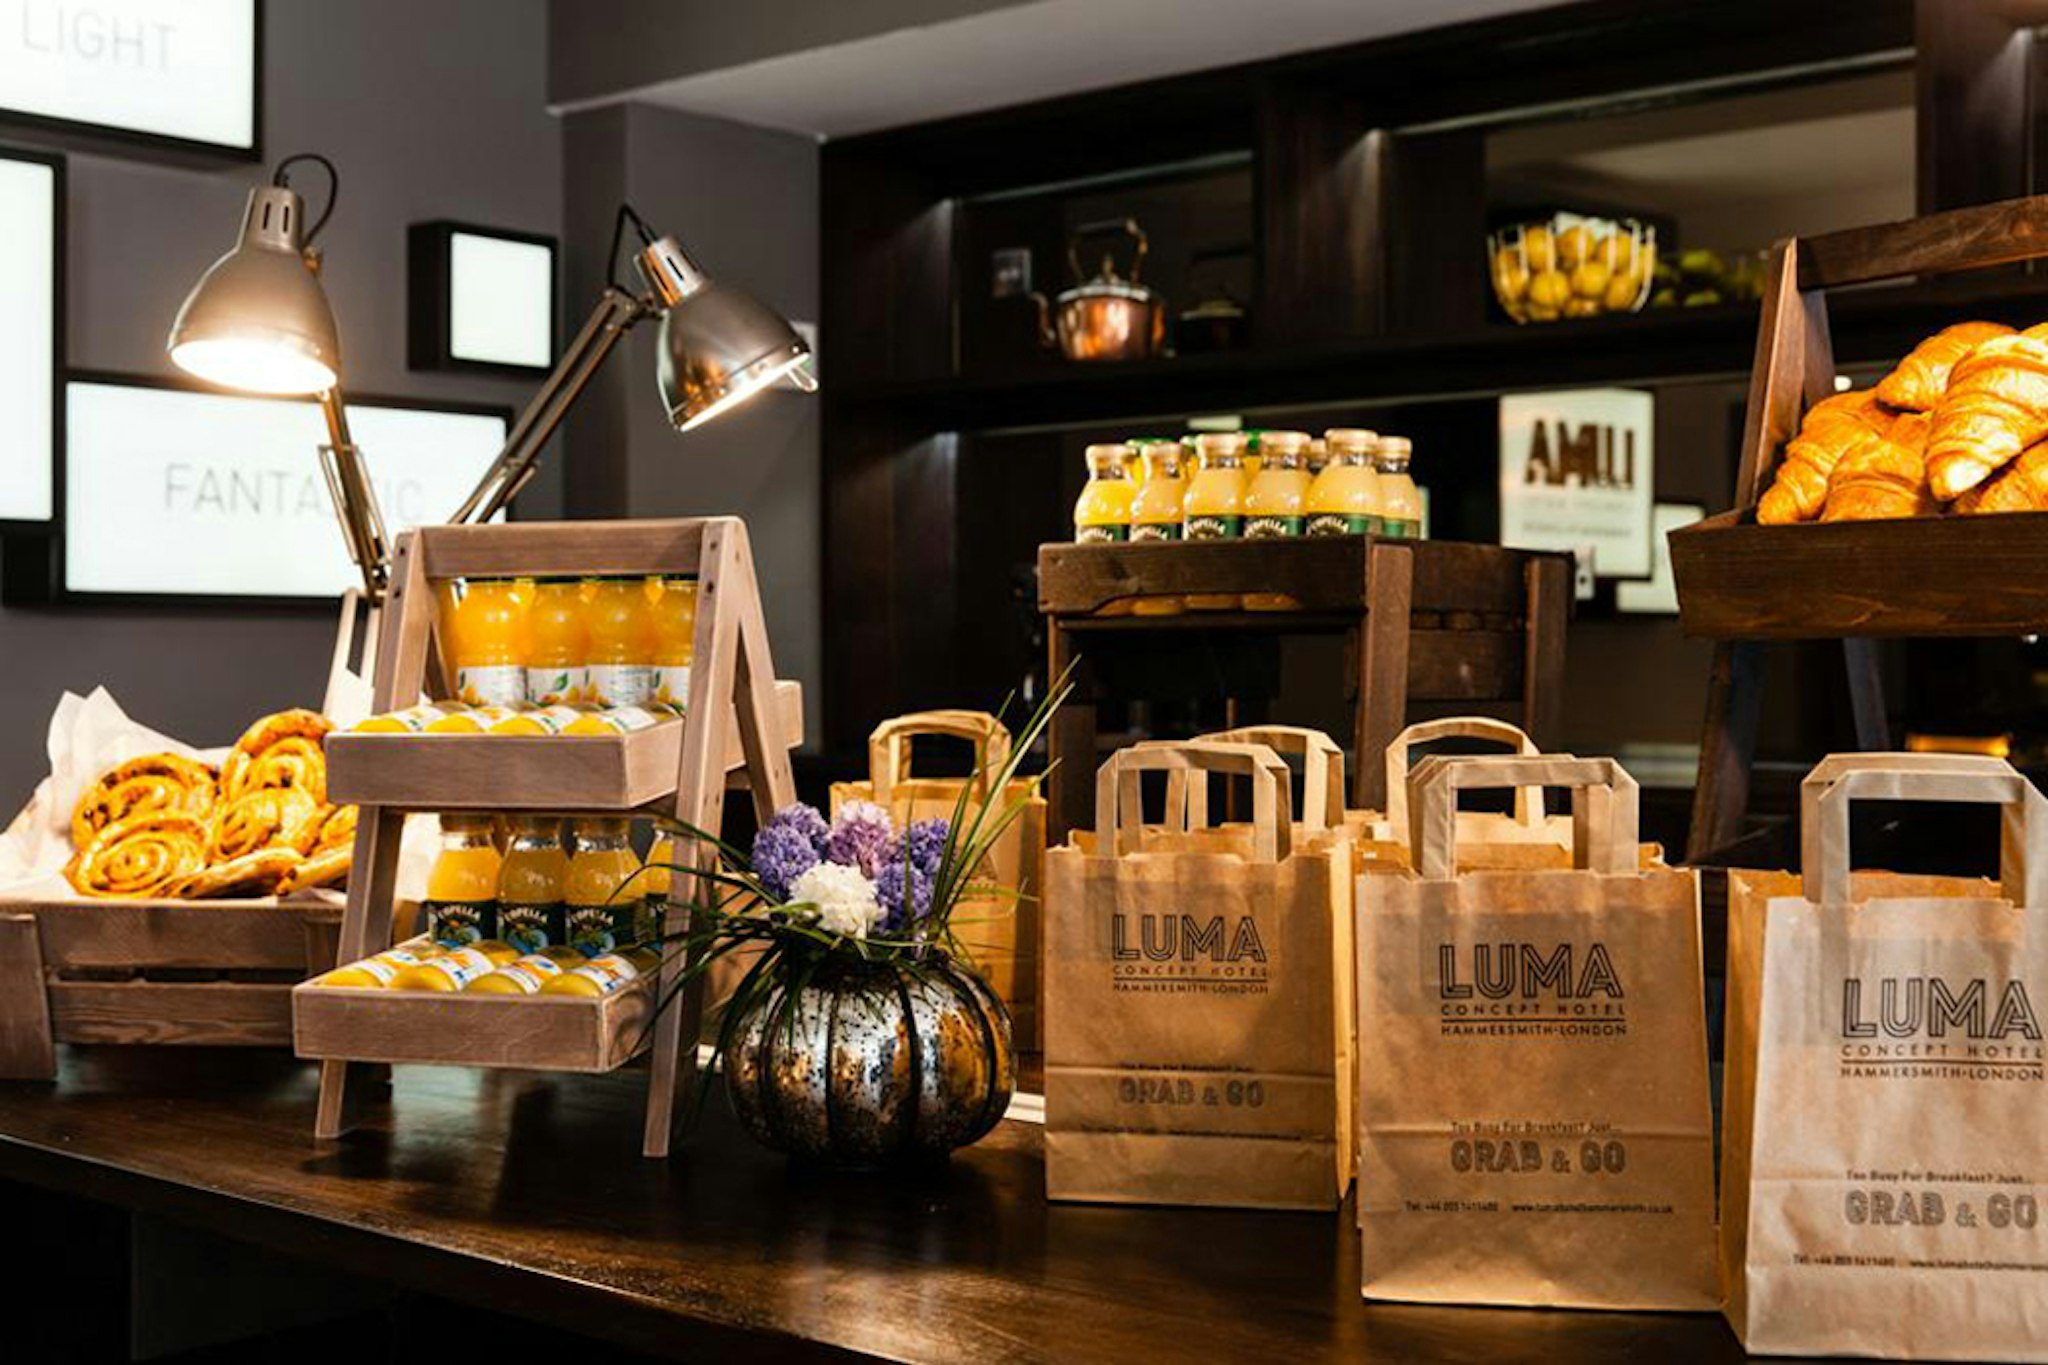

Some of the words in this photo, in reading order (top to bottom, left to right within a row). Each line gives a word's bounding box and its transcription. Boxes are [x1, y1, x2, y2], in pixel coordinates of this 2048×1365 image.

[21, 0, 177, 74] LIGHT
[164, 462, 424, 522] FANTAIC
[1112, 914, 1267, 963] LUMA
[1113, 964, 1197, 977] CONCEPT
[1211, 966, 1268, 979] HOTEL
[1439, 943, 1624, 999] LUMA
[1441, 1003, 1540, 1016] CONCEPT
[1558, 1003, 1625, 1016] HOTEL
[1842, 978, 2043, 1040] LUMA
[1842, 1044, 1949, 1057] CONCEPT
[1967, 1046, 2043, 1058] HOTEL
[1451, 1139, 1542, 1173] GRAB
[1551, 1148, 1571, 1174] &
[1580, 1140, 1626, 1174] GO
[1845, 1190, 1946, 1225] GRAB
[1955, 1202, 1977, 1227] &
[1987, 1193, 2038, 1229] GO
